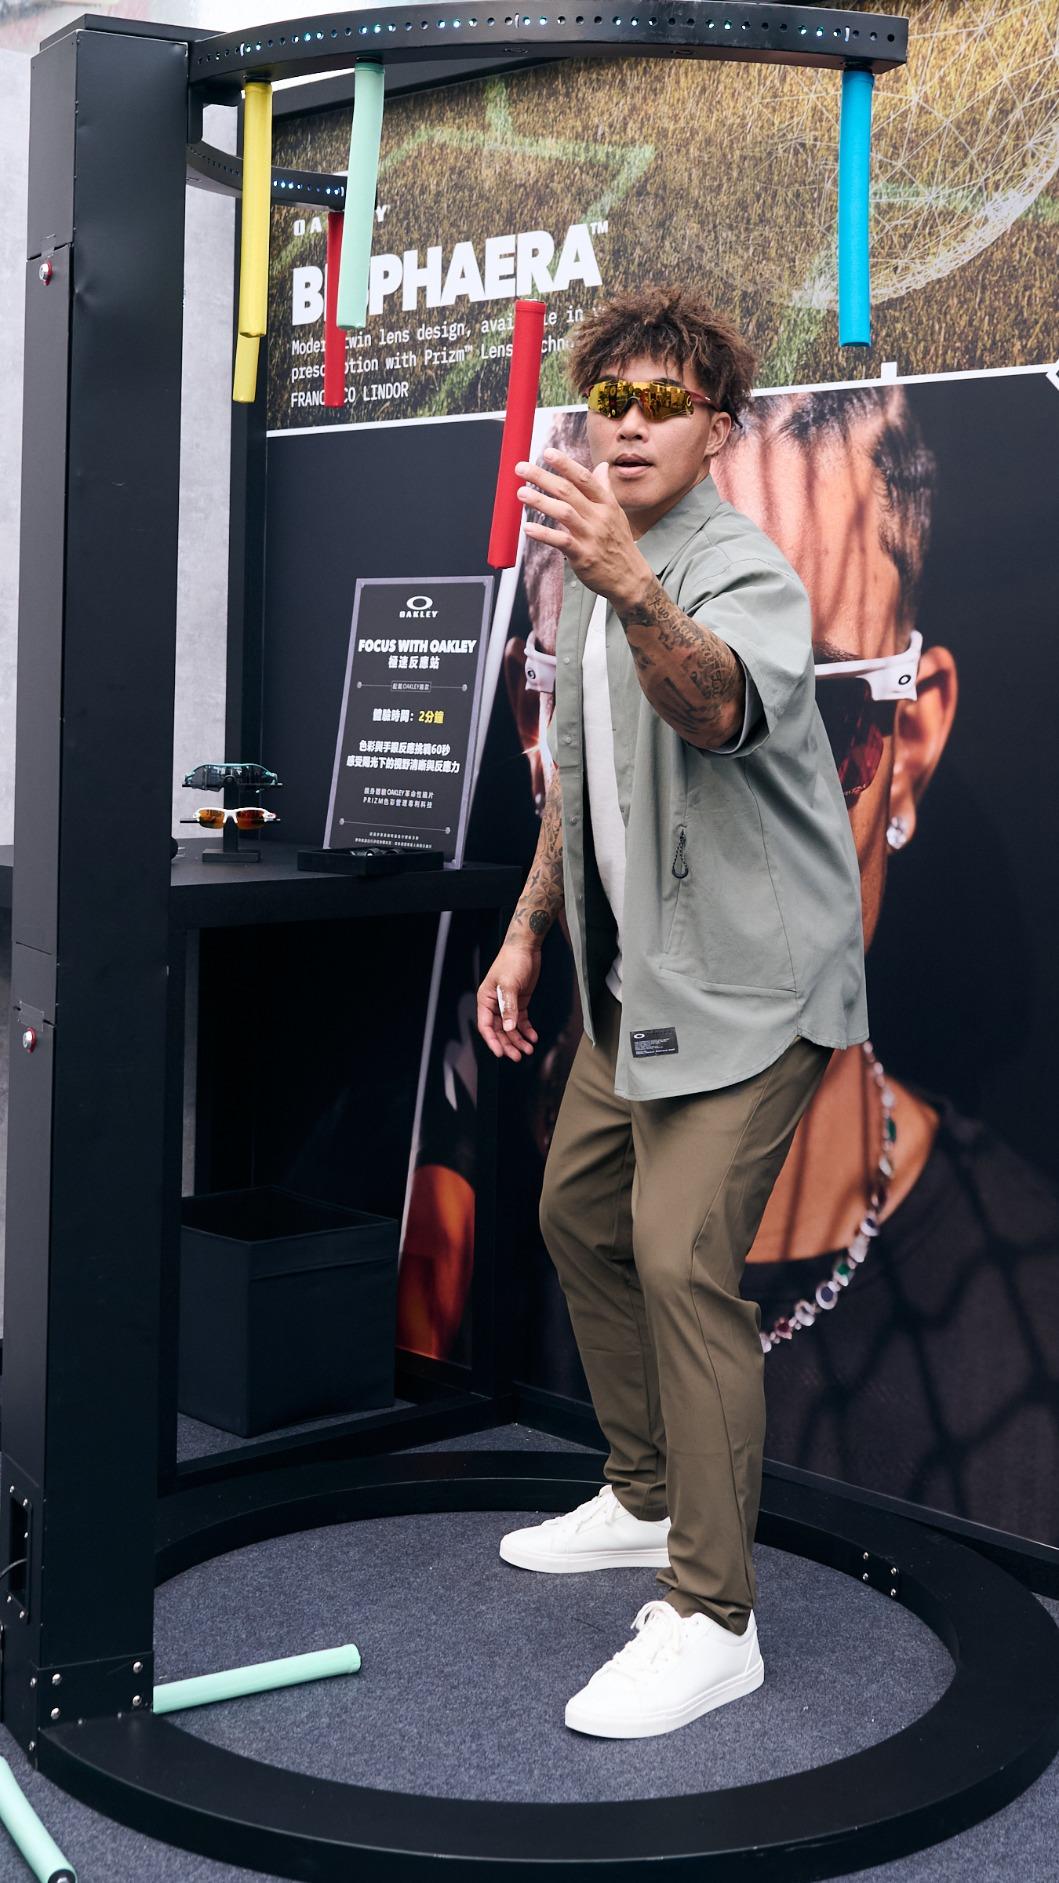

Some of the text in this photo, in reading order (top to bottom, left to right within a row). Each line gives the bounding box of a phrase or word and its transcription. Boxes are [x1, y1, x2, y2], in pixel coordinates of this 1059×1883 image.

[293, 205, 388, 236] OAY
[291, 337, 327, 355] Moder
[379, 328, 410, 345] lens
[417, 321, 471, 341] design,
[566, 305, 584, 323] in
[386, 351, 417, 369] with
[480, 343, 513, 359] Lens
[363, 381, 409, 401] LINDOR
[399, 610, 438, 618] OAKLEY
[358, 639, 477, 653] FOCUS WITH OAKLEY
[388, 655, 440, 669] 極速反應站
